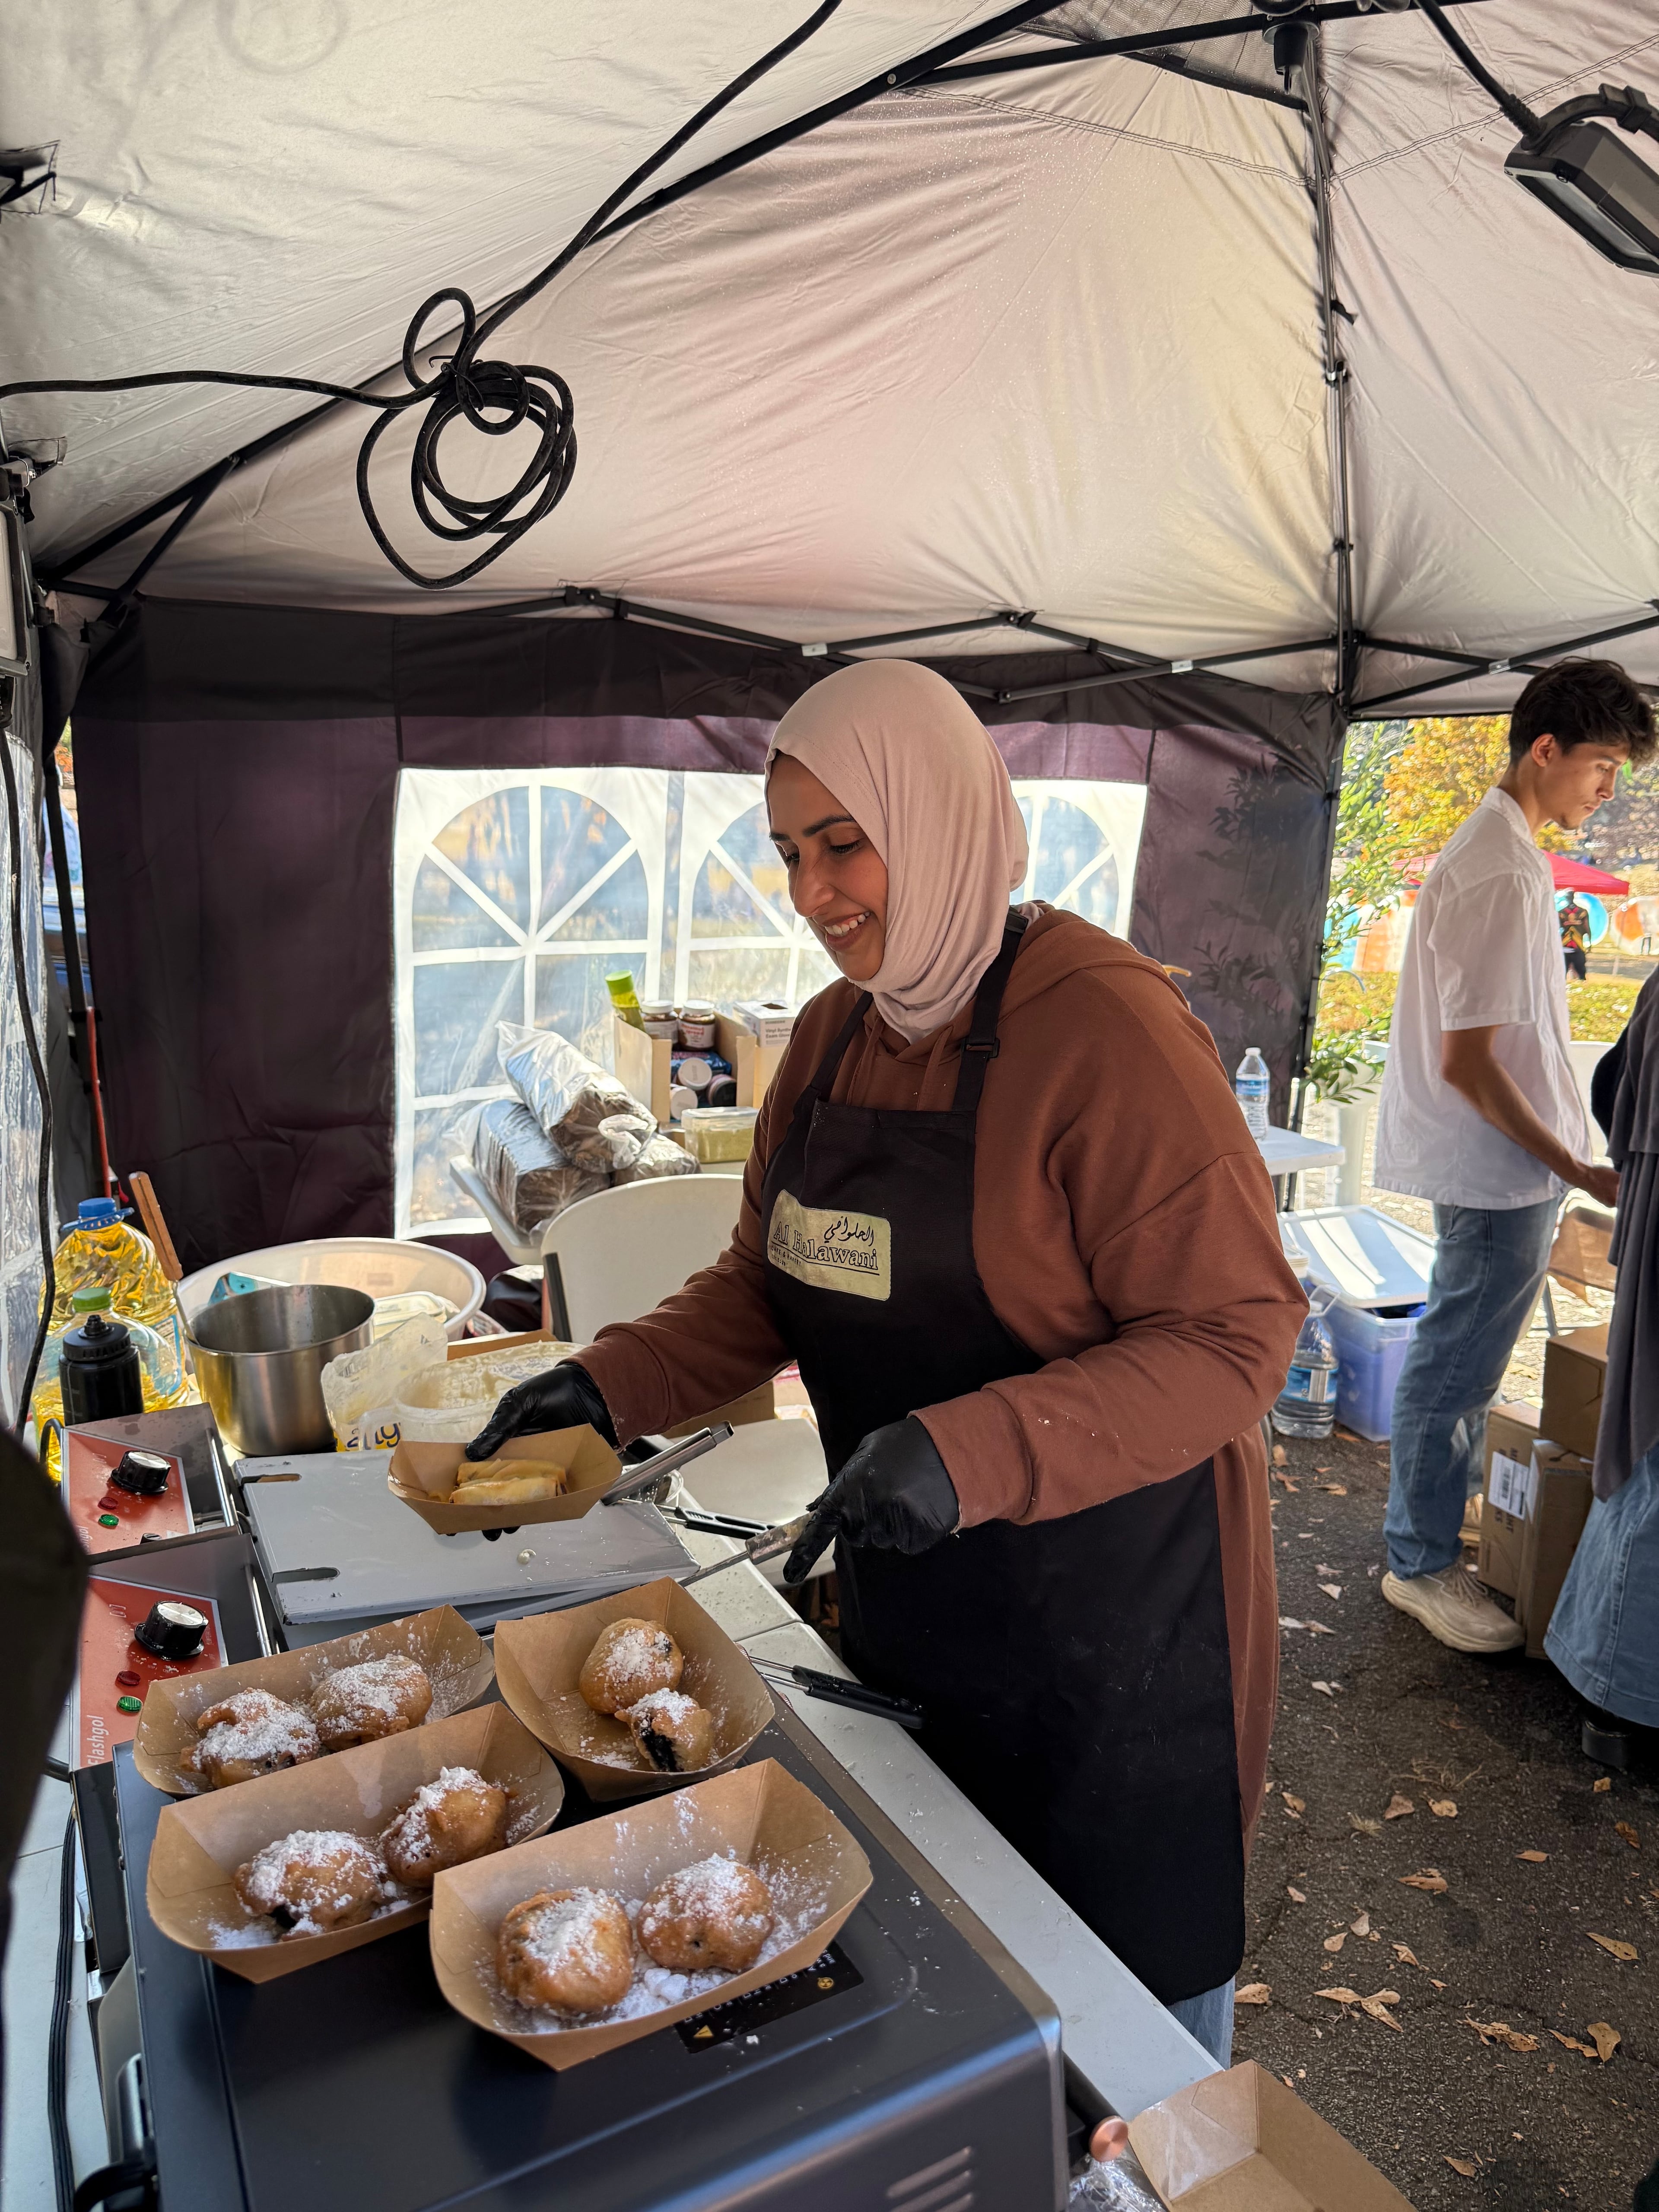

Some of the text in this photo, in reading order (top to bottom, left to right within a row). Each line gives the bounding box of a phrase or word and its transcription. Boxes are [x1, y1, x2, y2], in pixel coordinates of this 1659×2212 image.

[773, 1221, 878, 1270] Al Halawani
[787, 1254, 801, 1267] BAKERY
[86, 1714, 109, 1766] Flashgol
